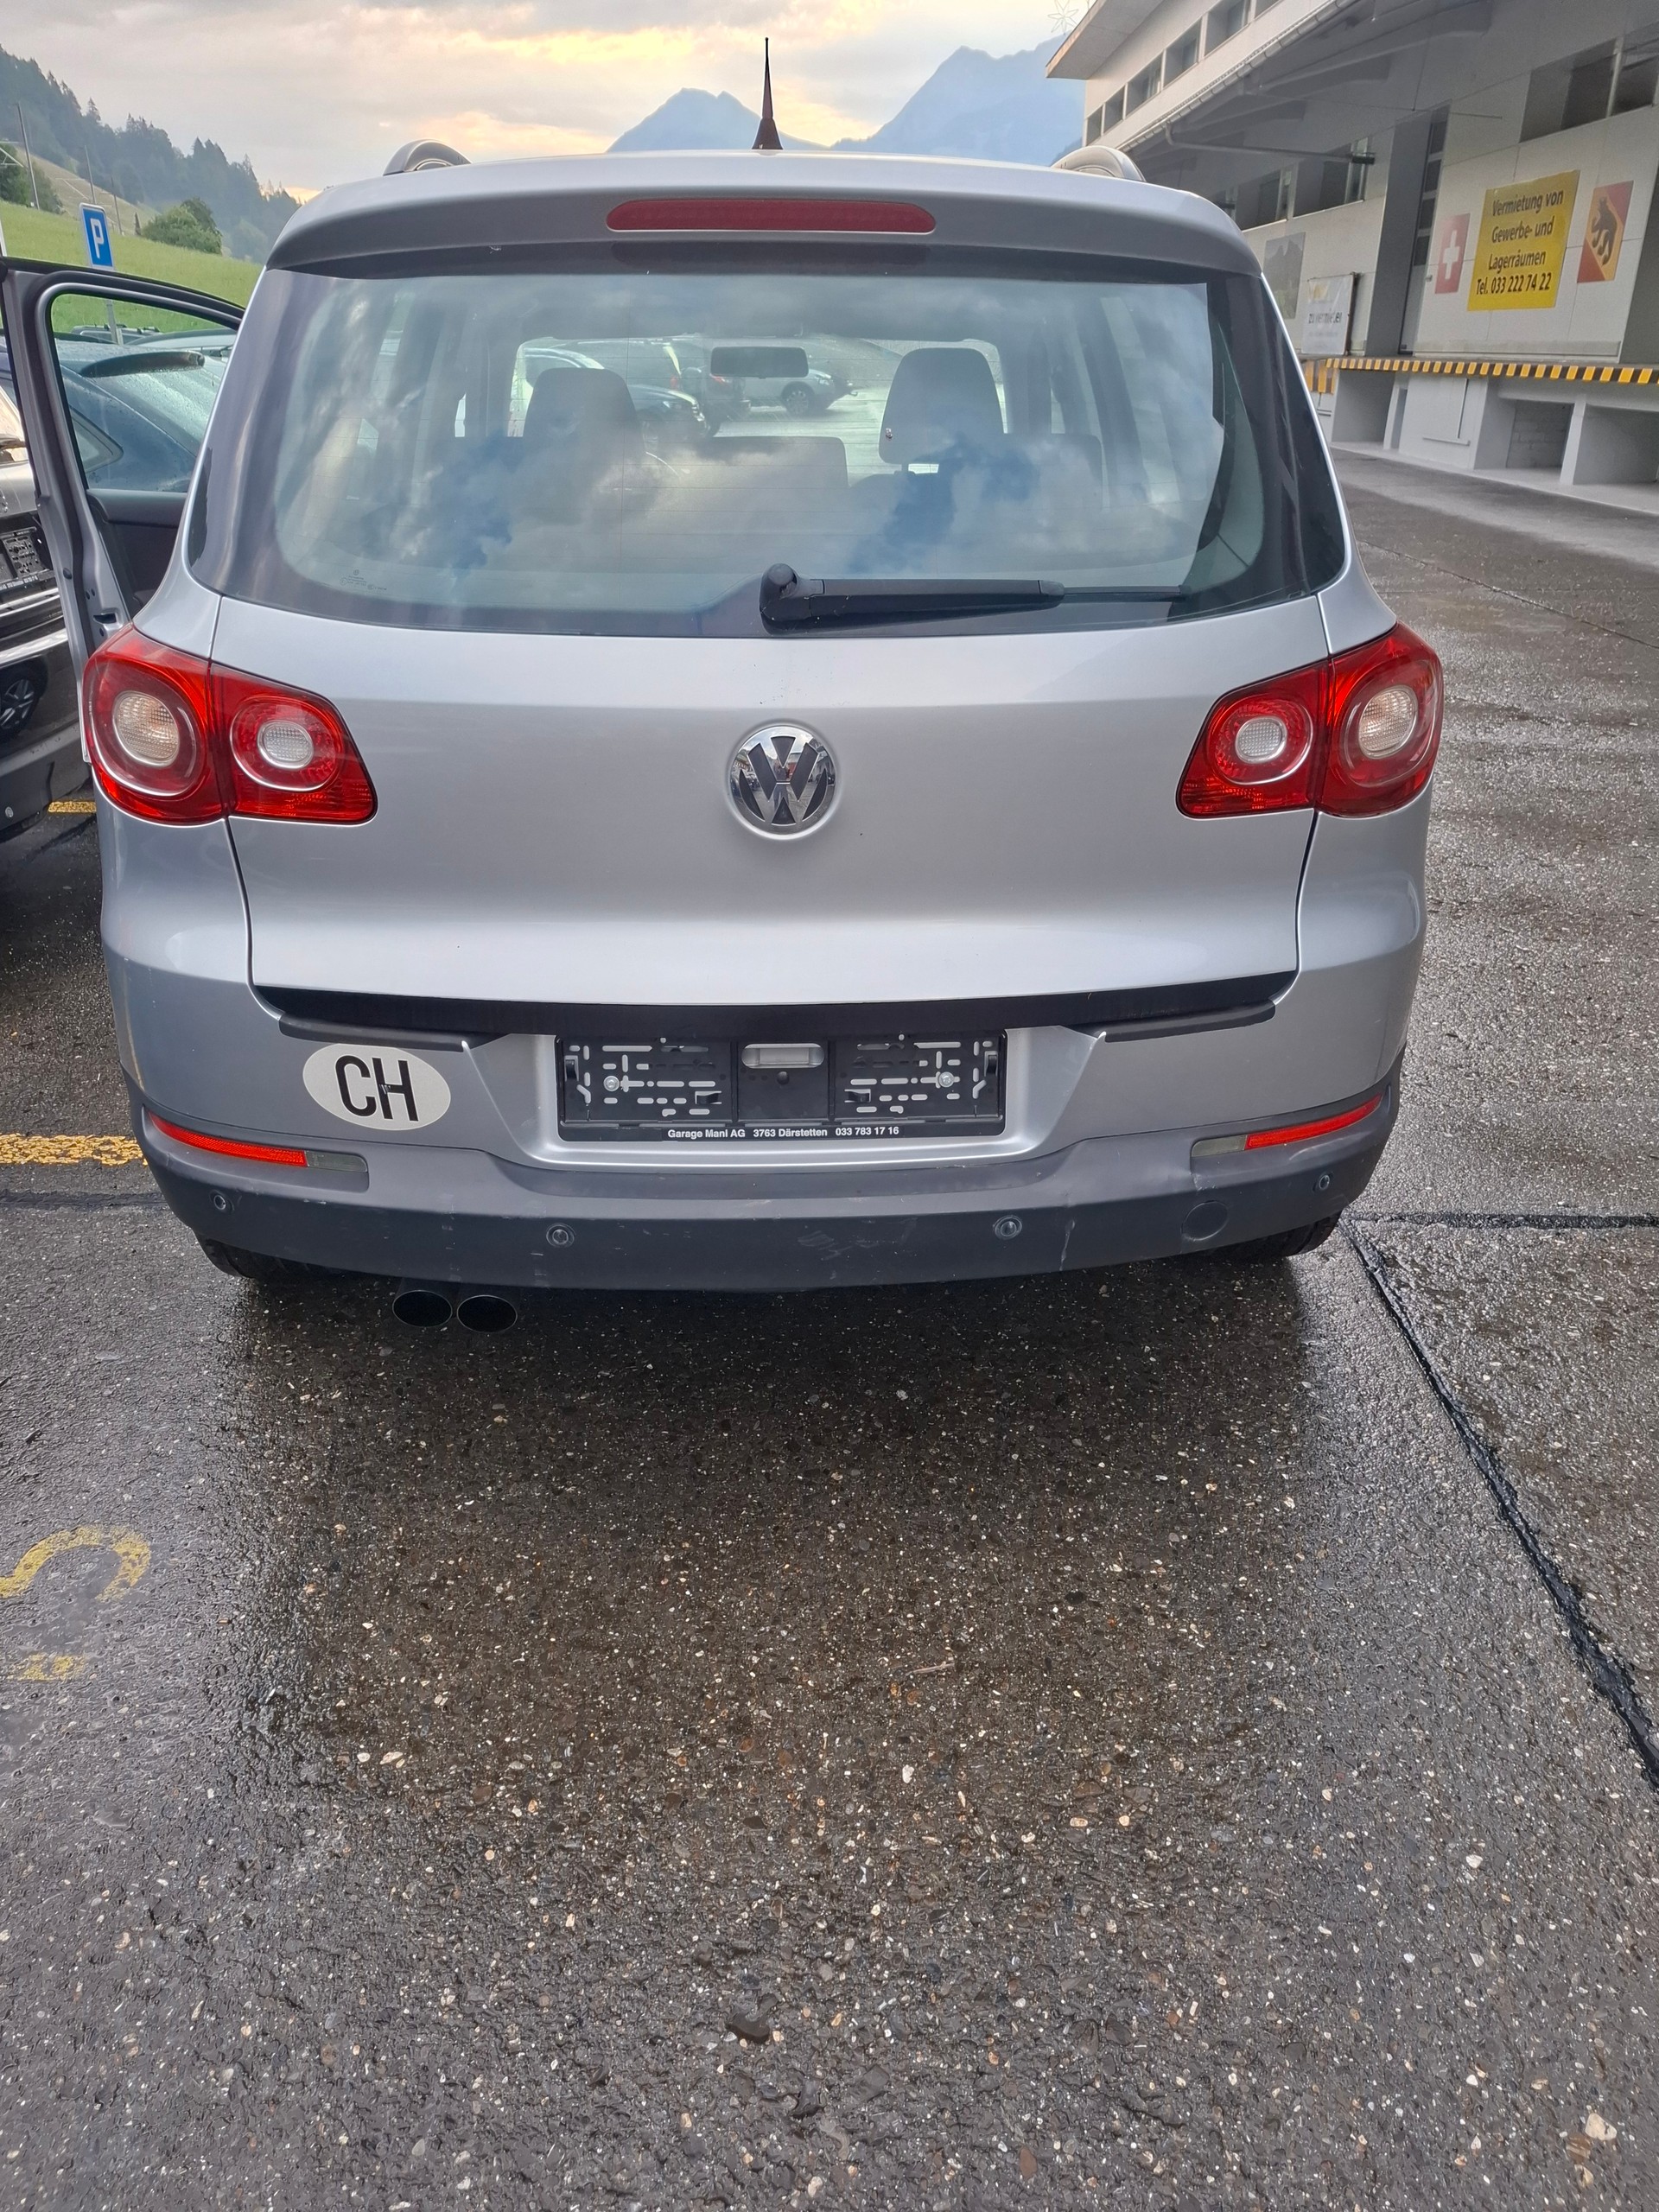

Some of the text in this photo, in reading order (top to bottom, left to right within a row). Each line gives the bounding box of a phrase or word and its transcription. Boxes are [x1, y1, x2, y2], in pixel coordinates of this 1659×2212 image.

[1492, 190, 1564, 216] Vermietung von
[90, 218, 104, 259] P
[1491, 216, 1555, 243] Gewerbe- und
[1489, 249, 1547, 274] Lagerräumen
[1476, 272, 1552, 295] Tel. 033 222 74 22
[334, 1055, 419, 1122] CH
[667, 1128, 703, 1140] Garage
[730, 1128, 746, 1138] AG
[753, 1128, 776, 1137] 3763
[778, 1128, 828, 1137] Därstetten
[835, 1127, 853, 1136] 033
[855, 1127, 872, 1136] 783
[874, 1127, 886, 1135] 17
[887, 1127, 899, 1135] 16
